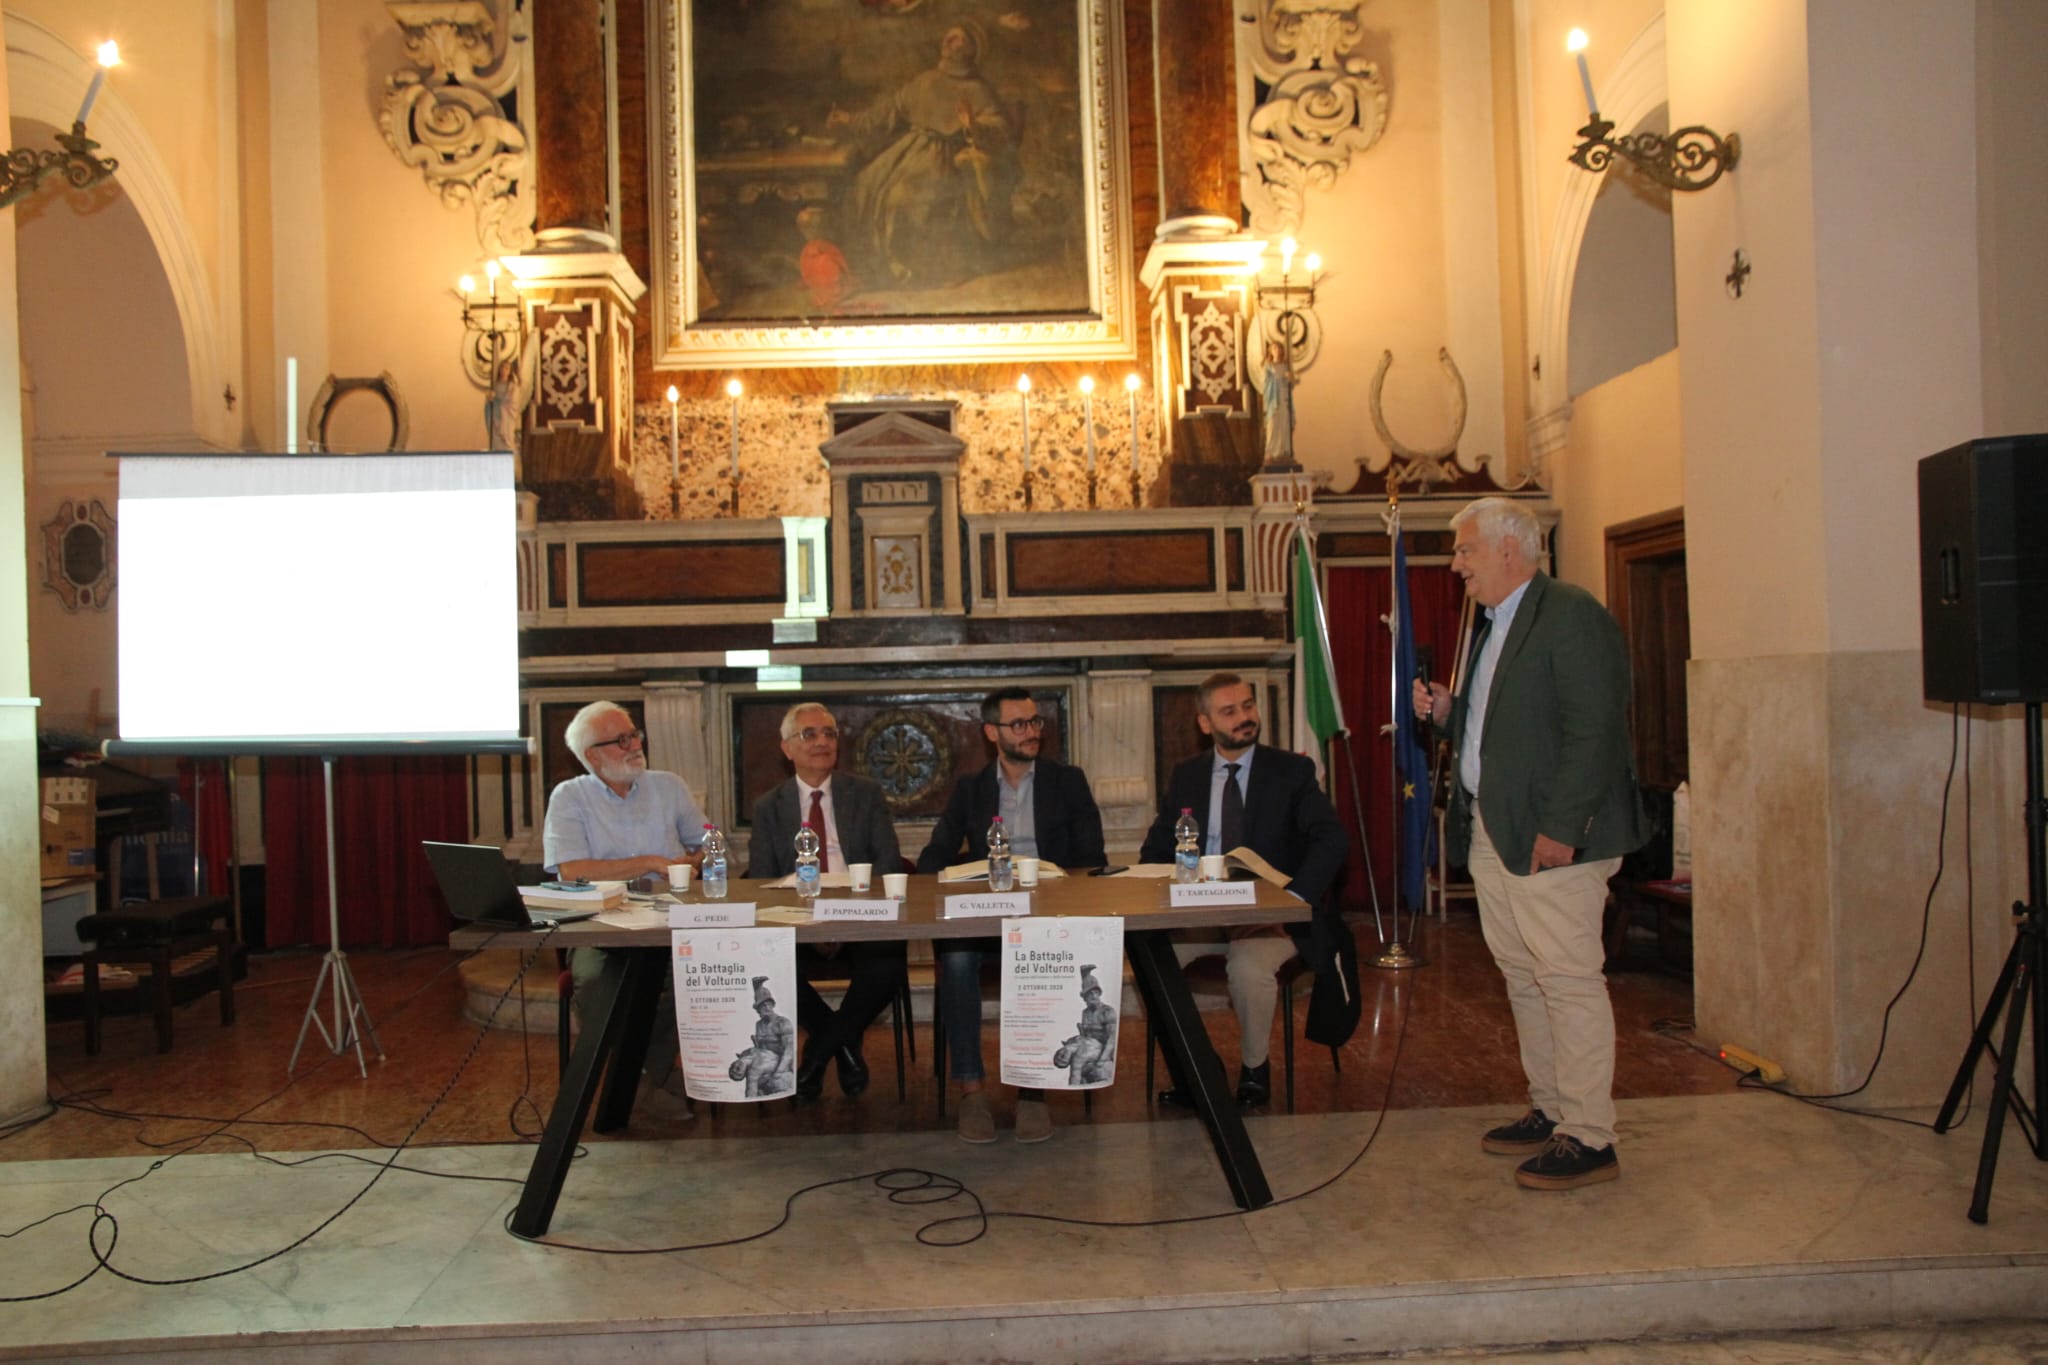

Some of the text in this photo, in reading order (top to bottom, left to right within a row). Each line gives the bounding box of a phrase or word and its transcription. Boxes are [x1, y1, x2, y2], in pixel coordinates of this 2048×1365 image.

[1187, 887, 1248, 897] TARTAGLIONE
[970, 902, 1016, 910] VALLETTA
[832, 908, 889, 916] PAPPALARDO
[1015, 951, 1074, 962] La Battaglia
[686, 963, 745, 975] La Battaglia
[1015, 963, 1075, 974] del Volturno
[686, 976, 747, 987] del Volturno
